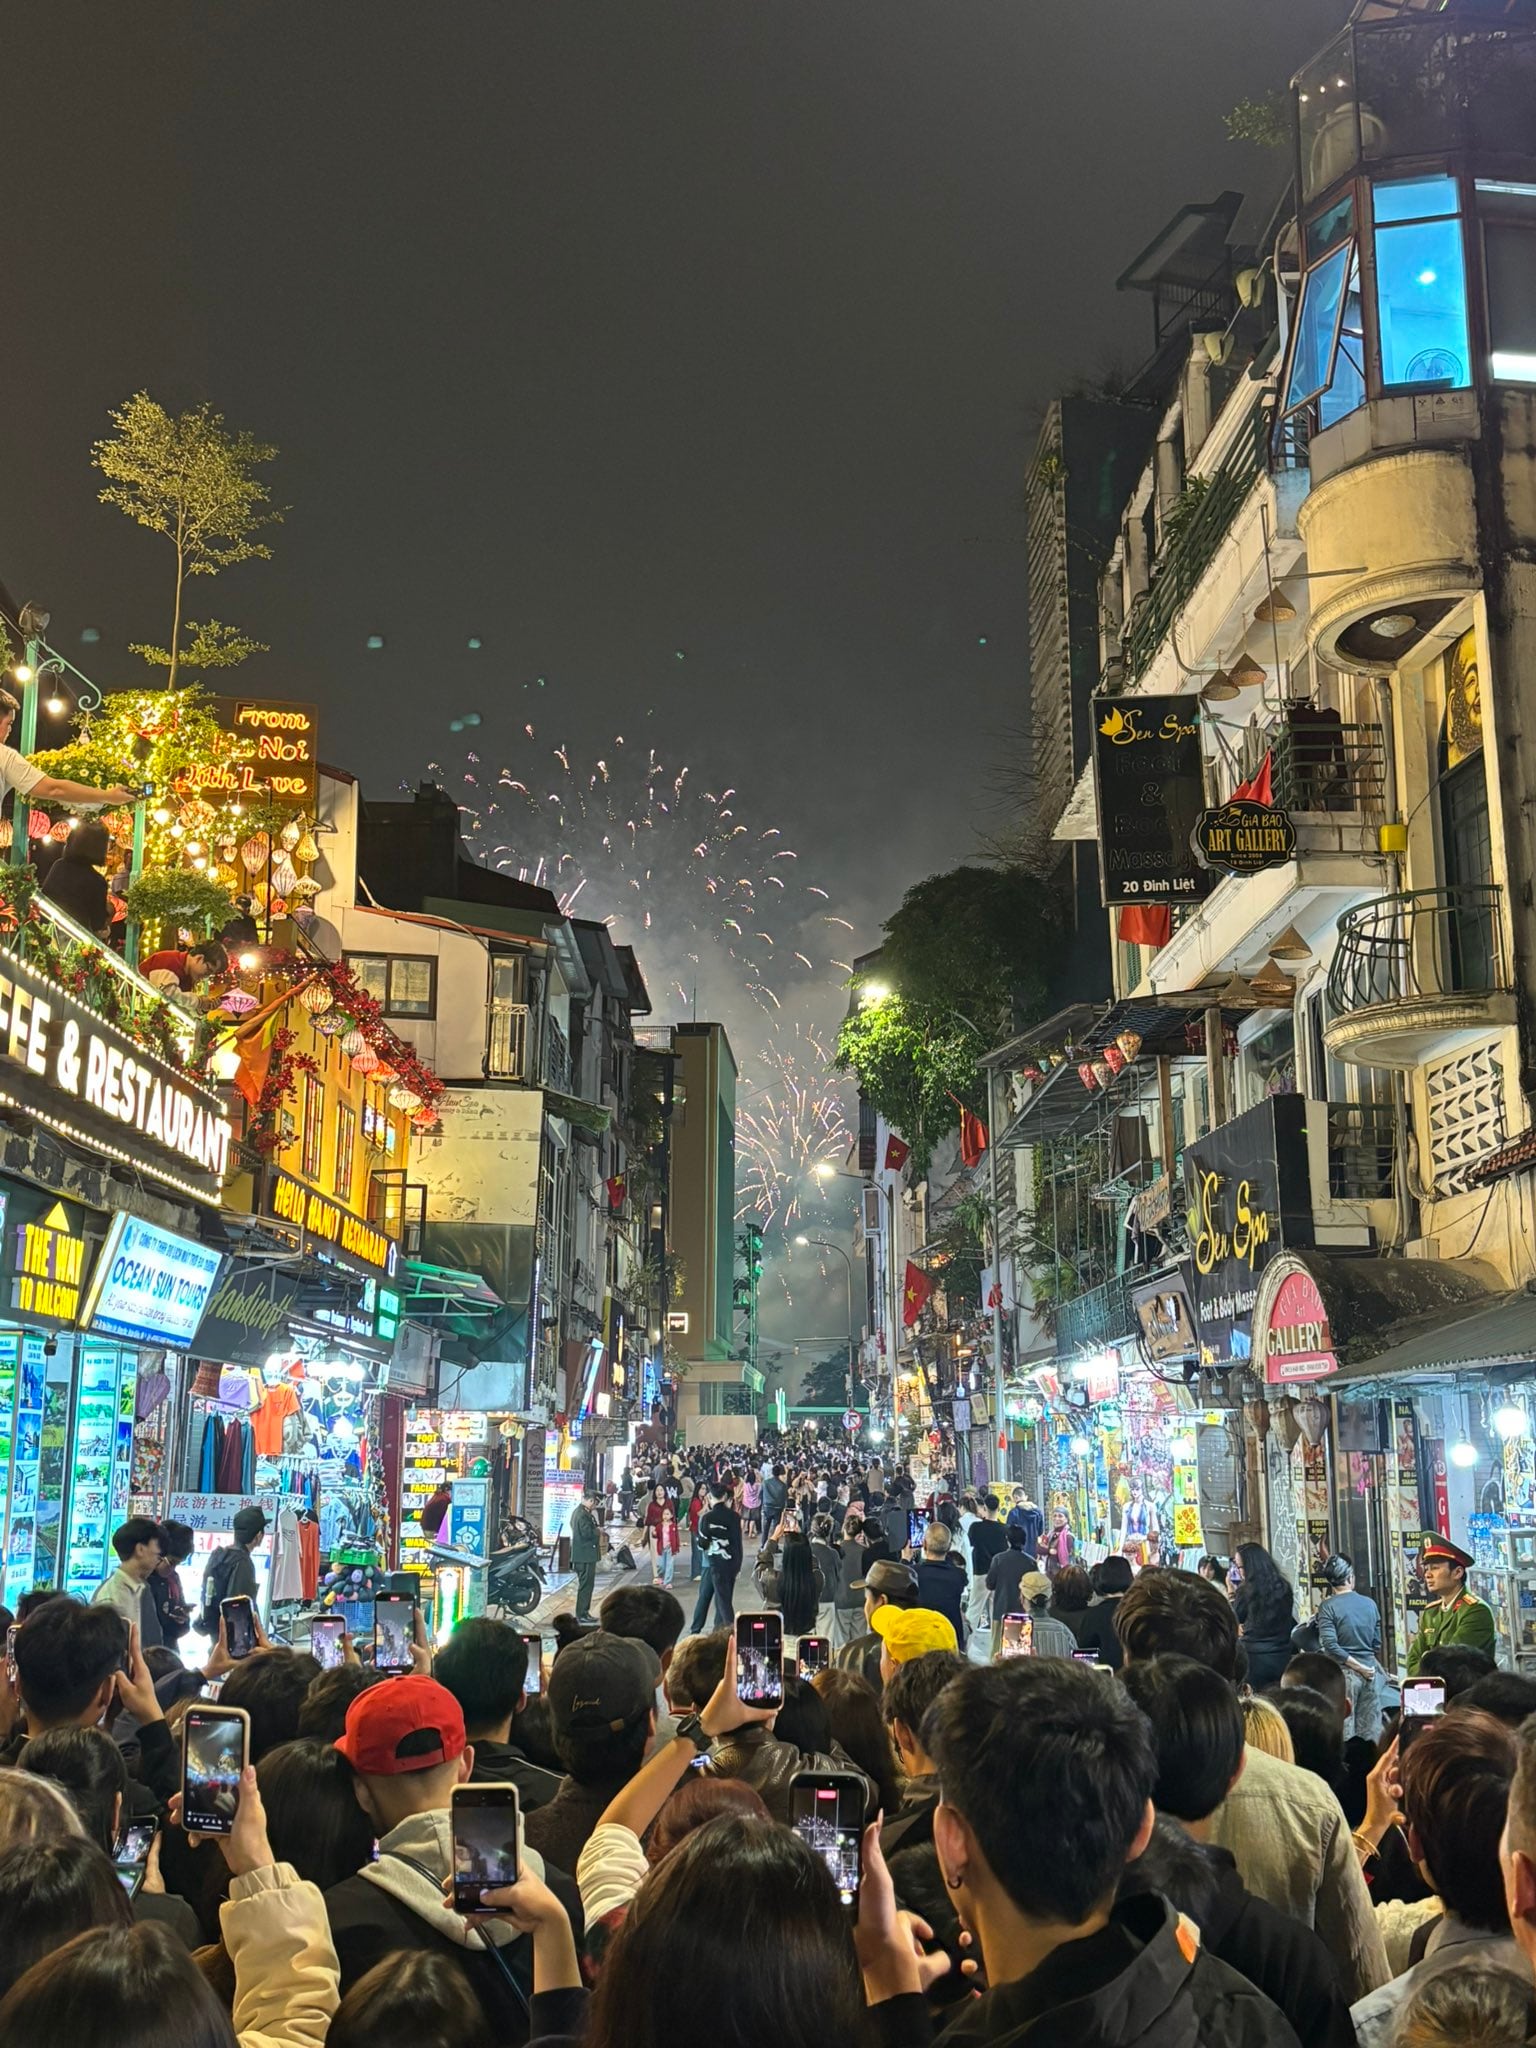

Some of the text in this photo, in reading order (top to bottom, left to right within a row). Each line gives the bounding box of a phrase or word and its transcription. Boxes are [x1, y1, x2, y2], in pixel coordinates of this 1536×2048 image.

[234, 702, 310, 730] From
[1112, 709, 1197, 745] Sen Spa
[258, 735, 309, 761] Noi
[1115, 751, 1182, 776] Foot
[1140, 782, 1165, 807] &
[1208, 829, 1287, 851] ART GALLERY
[1123, 881, 1139, 893] 20
[1173, 877, 1196, 893] Liệt
[57, 1019, 81, 1095] &
[85, 1034, 232, 1176] RESTAURANT
[1196, 1170, 1269, 1275] Sen Spa
[23, 1223, 84, 1285] THE WAY
[19, 1276, 34, 1311] TO
[34, 1280, 79, 1320] BALCONY
[112, 1256, 157, 1293] OCEAN
[152, 1270, 178, 1301] SUN
[174, 1278, 208, 1311] TOURS
[1200, 1301, 1214, 1324] Foot
[1213, 1297, 1220, 1320] &
[1219, 1292, 1235, 1322] Body
[1267, 1320, 1323, 1356] GALLERY
[417, 1433, 438, 1443] FOOT
[415, 1458, 437, 1468] BODY
